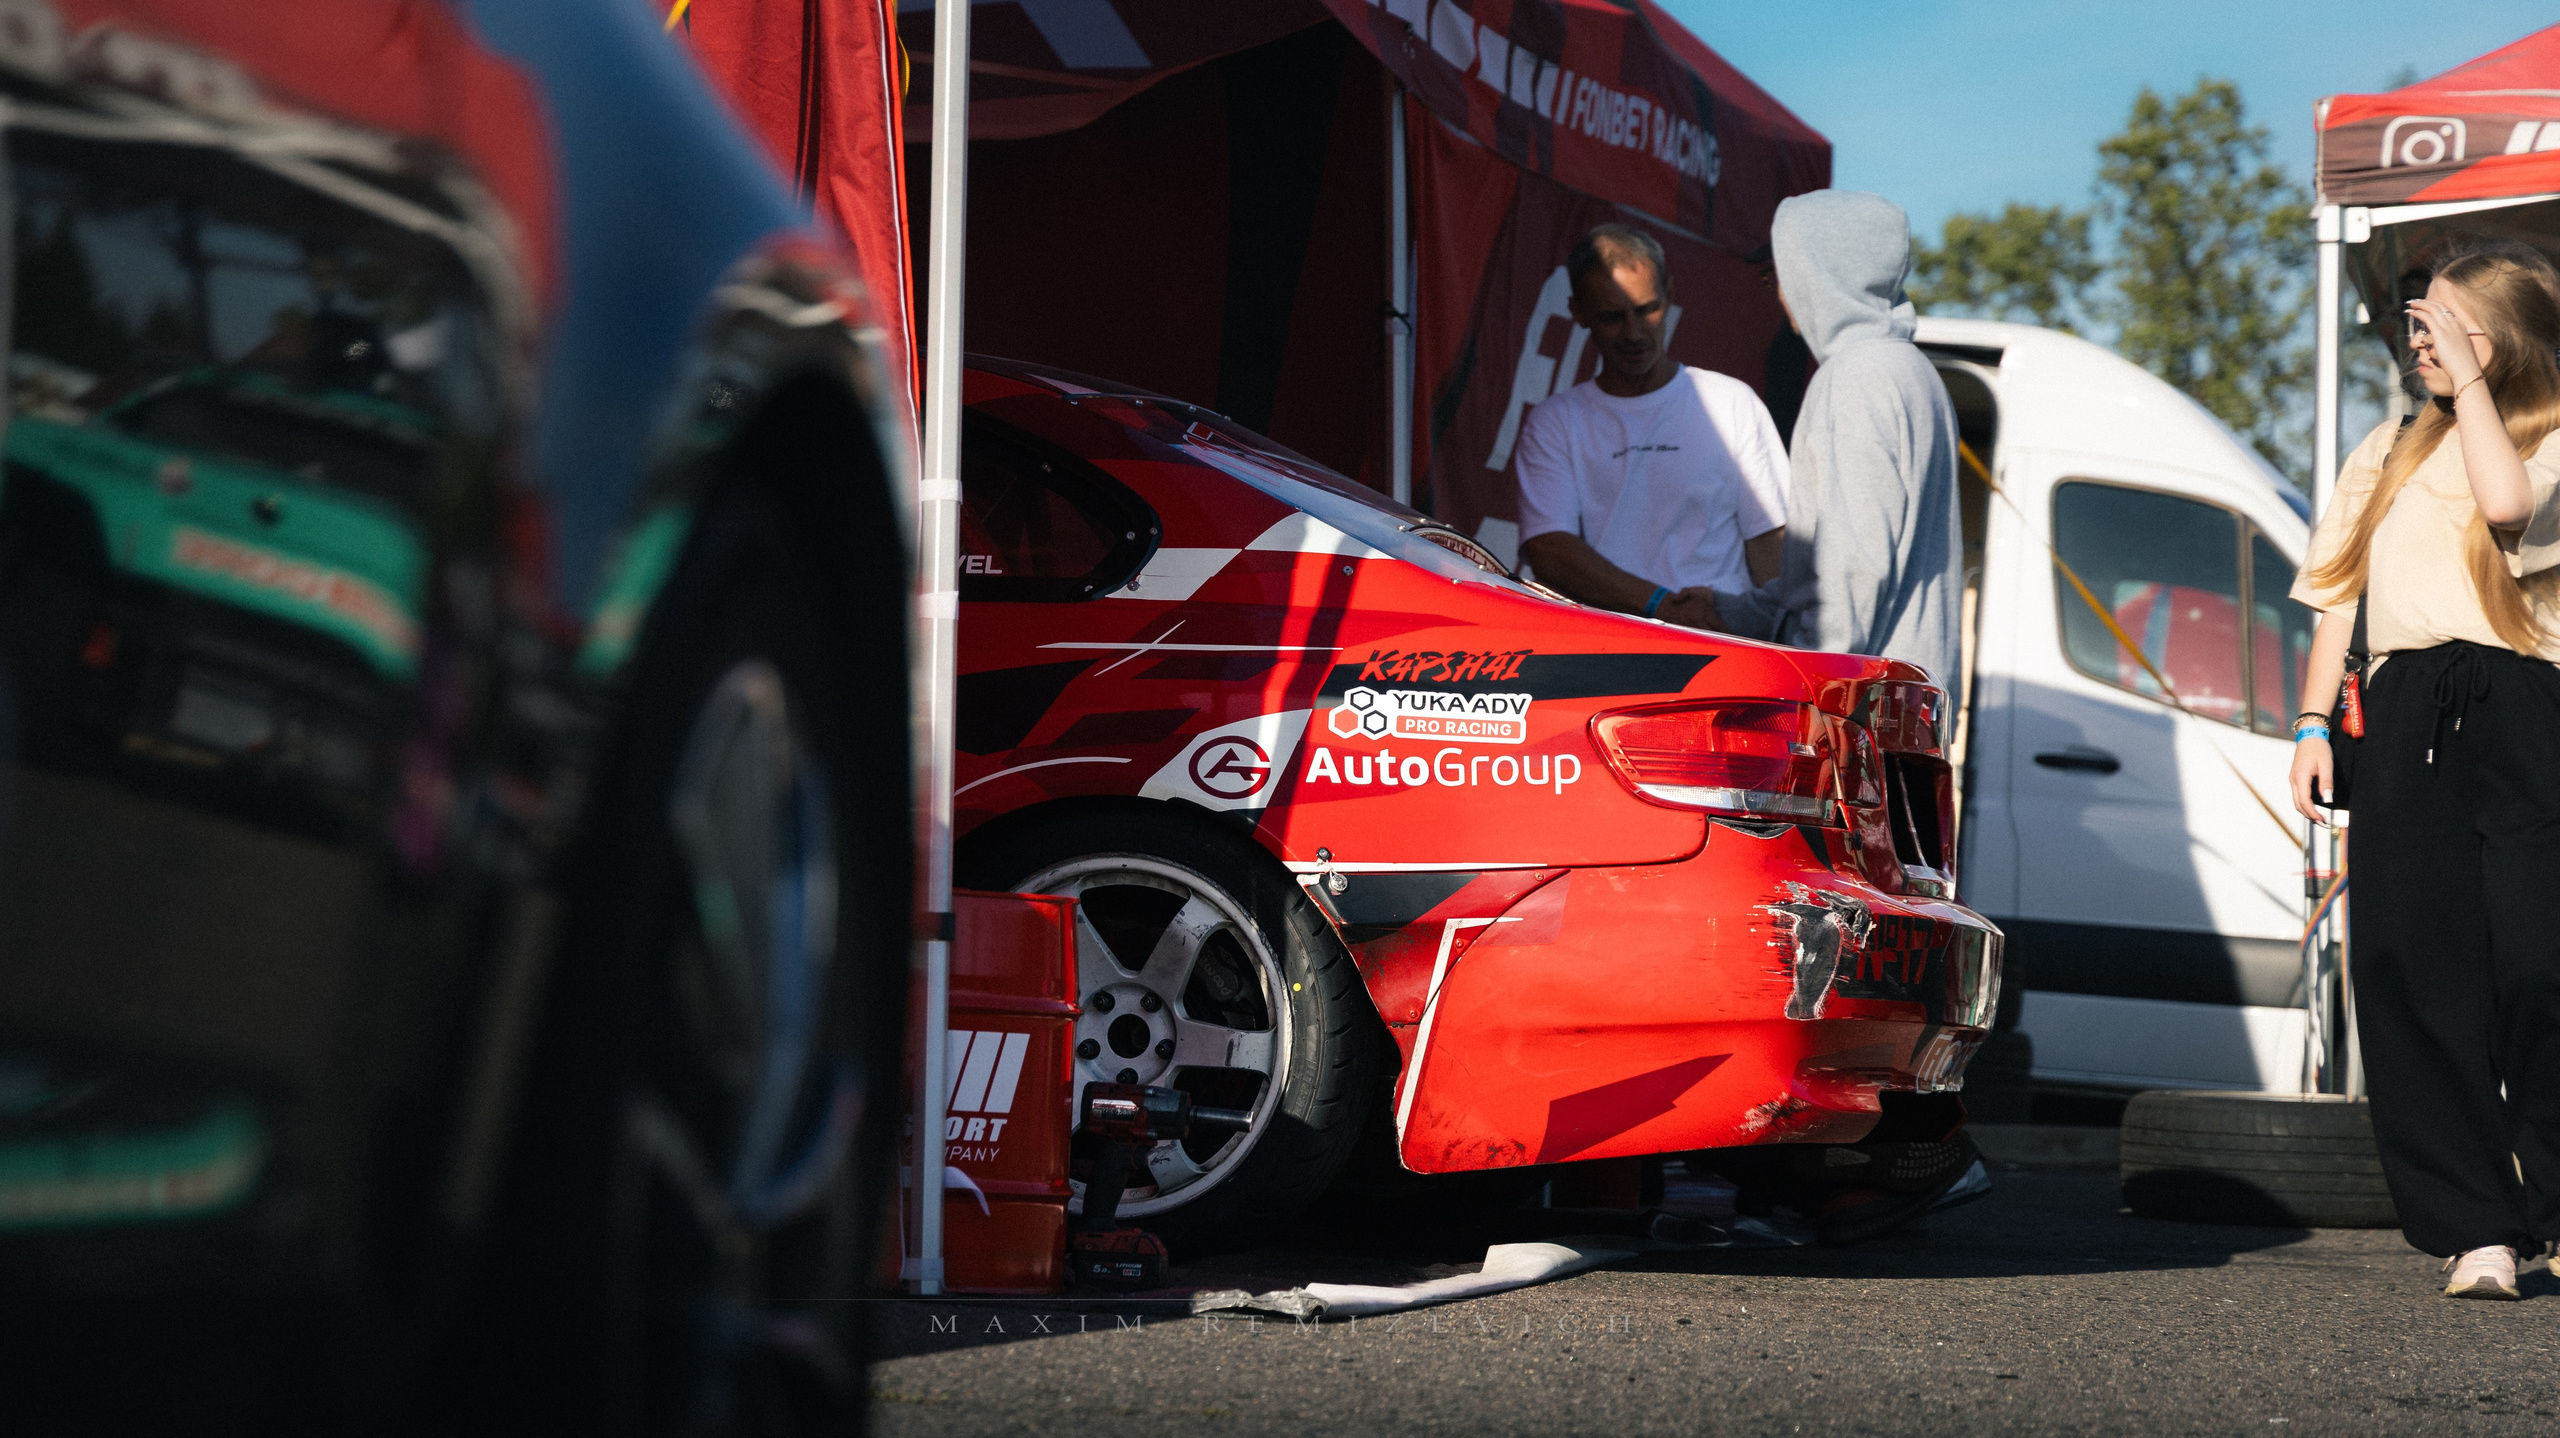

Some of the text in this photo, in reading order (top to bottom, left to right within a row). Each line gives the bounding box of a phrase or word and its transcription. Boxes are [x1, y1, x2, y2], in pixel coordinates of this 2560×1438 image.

[1569, 76, 1720, 187] FONBET RACING
[1358, 649, 1534, 683] KAPSHAI
[1392, 693, 1527, 715] YUKA ADV
[1405, 719, 1512, 736] PRO RACING
[1305, 747, 1582, 795] AutoGroup
